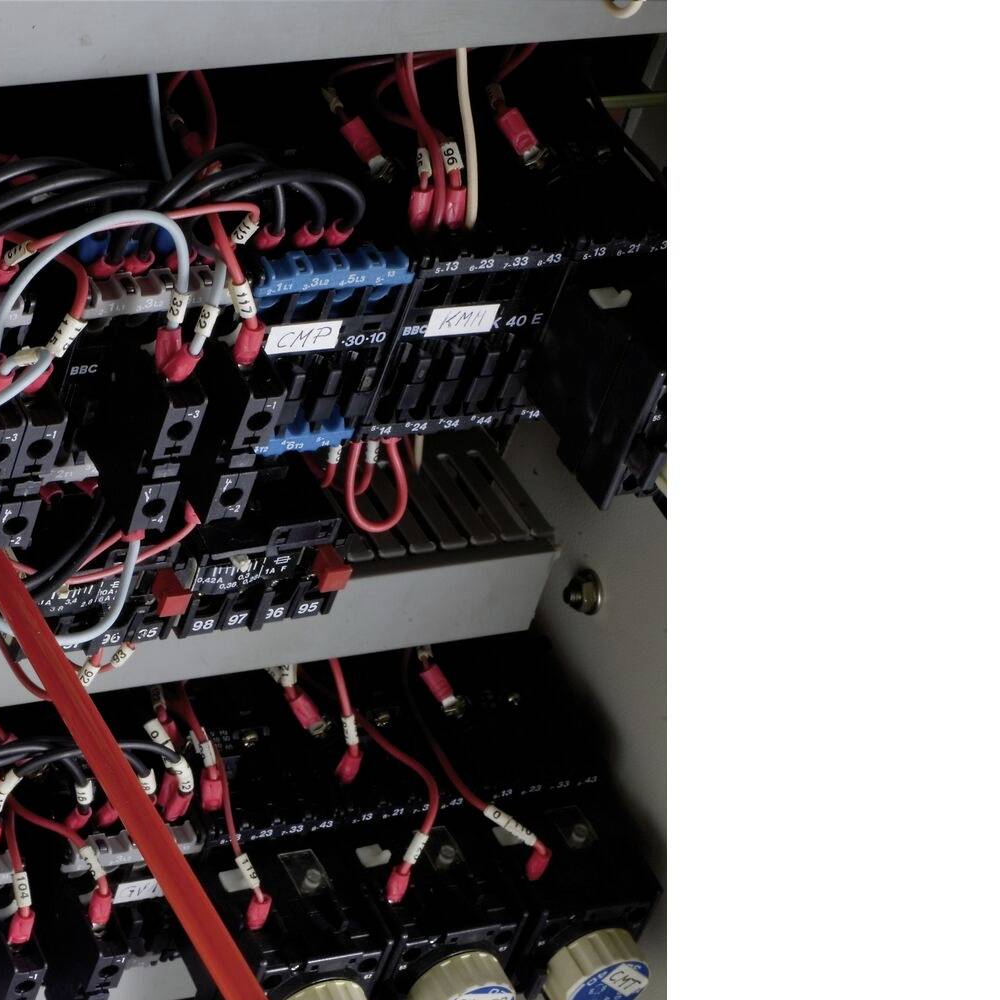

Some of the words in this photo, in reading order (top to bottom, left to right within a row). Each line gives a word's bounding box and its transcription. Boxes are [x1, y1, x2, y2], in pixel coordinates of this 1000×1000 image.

[444, 147, 458, 166] 96
[169, 296, 184, 317] 32
[198, 310, 211, 330] 32
[505, 314, 527, 328] 40
[530, 313, 544, 325] E
[69, 364, 98, 376] BBC
[192, 619, 215, 631] 98
[227, 613, 249, 626] 97
[297, 601, 319, 614] 95
[242, 859, 258, 880] 119
[18, 875, 30, 899] 104
